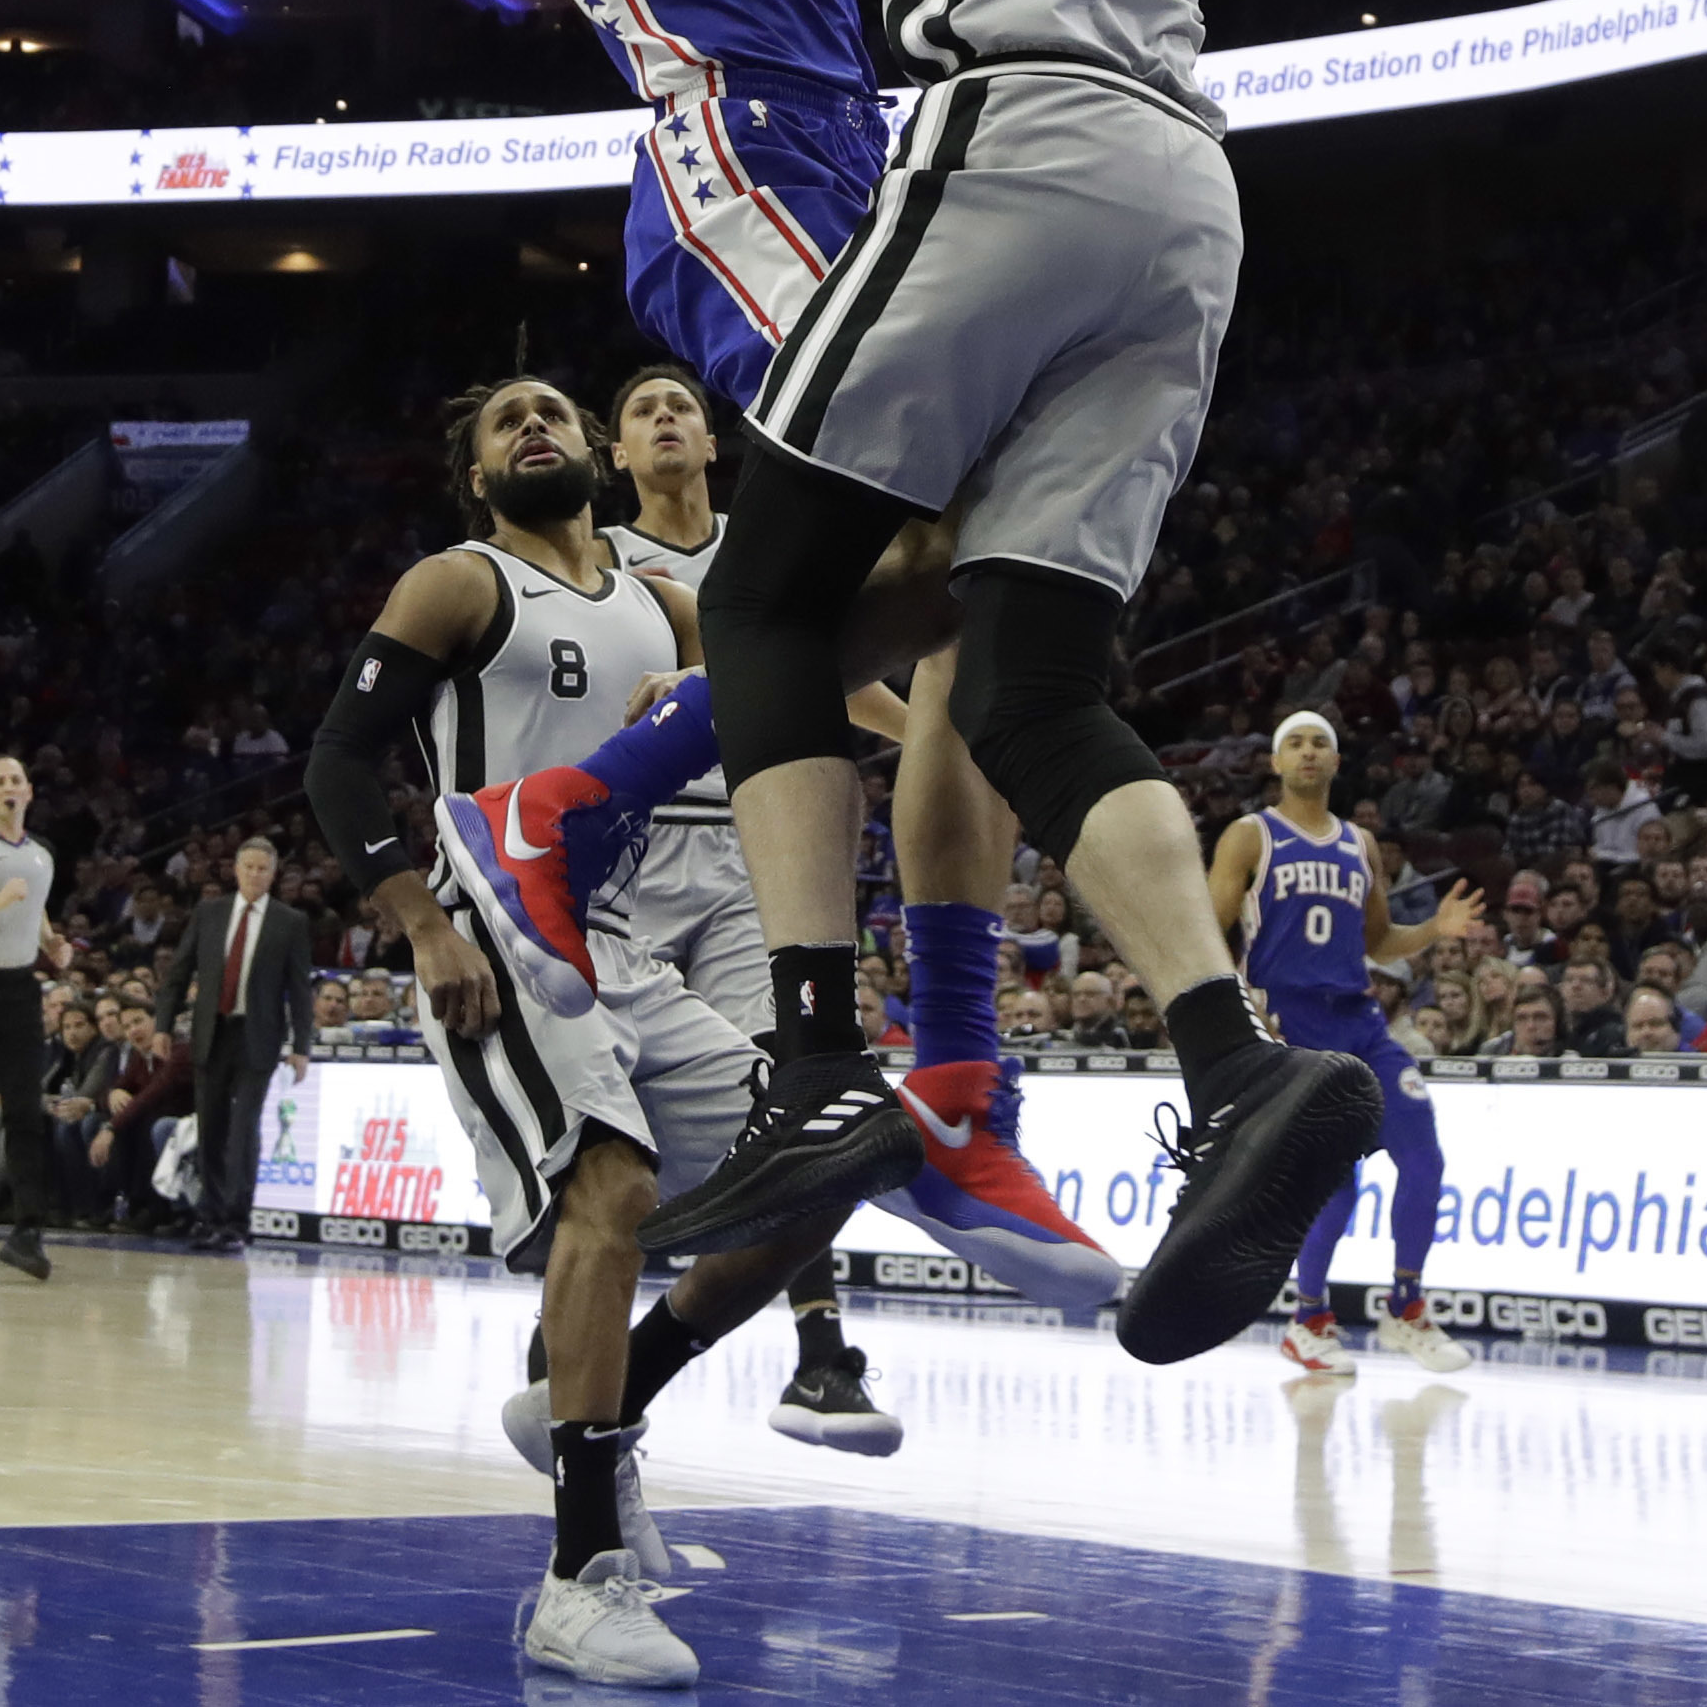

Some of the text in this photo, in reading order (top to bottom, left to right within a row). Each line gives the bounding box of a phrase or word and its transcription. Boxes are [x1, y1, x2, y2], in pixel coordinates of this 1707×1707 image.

[1234, 64, 1314, 98] Radio
[1323, 54, 1422, 87] Station
[1431, 39, 1463, 72] of
[1470, 37, 1514, 66] the
[1522, 5, 1679, 57] Philadelphia
[273, 131, 634, 176] Flagship Radio Station of
[547, 636, 590, 700] 8
[1273, 860, 1366, 909] PHILA
[1305, 905, 1332, 945] 0
[361, 1118, 407, 1162] 97.5
[330, 1161, 442, 1223] FANATIC
[1107, 1153, 1168, 1228] of
[251, 1209, 299, 1238] EICO
[320, 1216, 386, 1246] GEICO
[399, 1224, 468, 1255] GEICO
[875, 1254, 969, 1288] GEICO
[1489, 1296, 1607, 1339] GEICO
